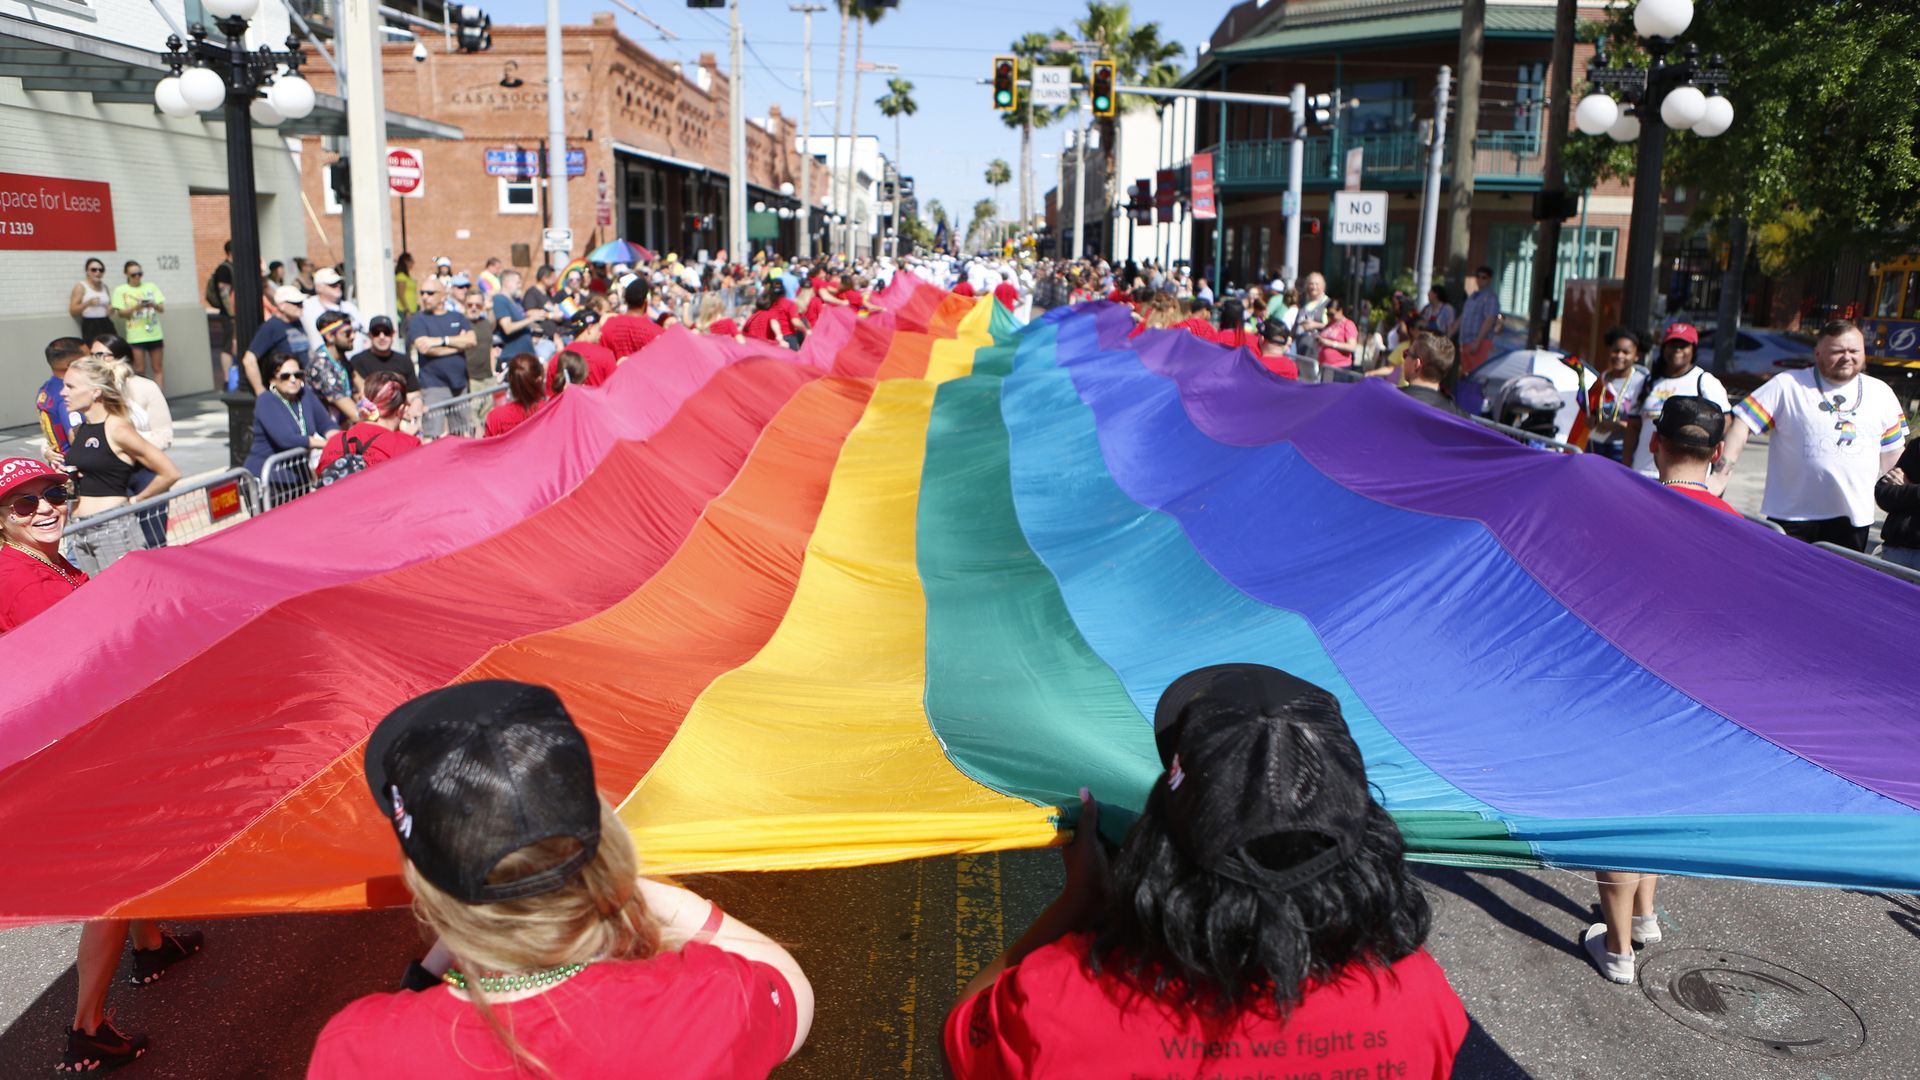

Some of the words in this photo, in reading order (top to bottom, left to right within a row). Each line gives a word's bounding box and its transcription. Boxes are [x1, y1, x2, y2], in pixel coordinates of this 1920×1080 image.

[1042, 72, 1060, 83] NO
[1037, 89, 1068, 98] TURNS
[389, 156, 399, 166] DO
[400, 157, 418, 167] NOT
[0, 190, 37, 212] pace
[40, 187, 60, 210] for
[62, 191, 101, 212] Lease
[1350, 201, 1372, 215] NO
[9, 221, 34, 235] 1319
[1339, 222, 1381, 234] TURNS
[1160, 1036, 1242, 1060] When
[1249, 1040, 1288, 1058] we
[1296, 1029, 1355, 1059] fight
[1362, 1029, 1388, 1049] as
[1331, 1067, 1369, 1080] are
[1376, 1058, 1407, 1080] the
